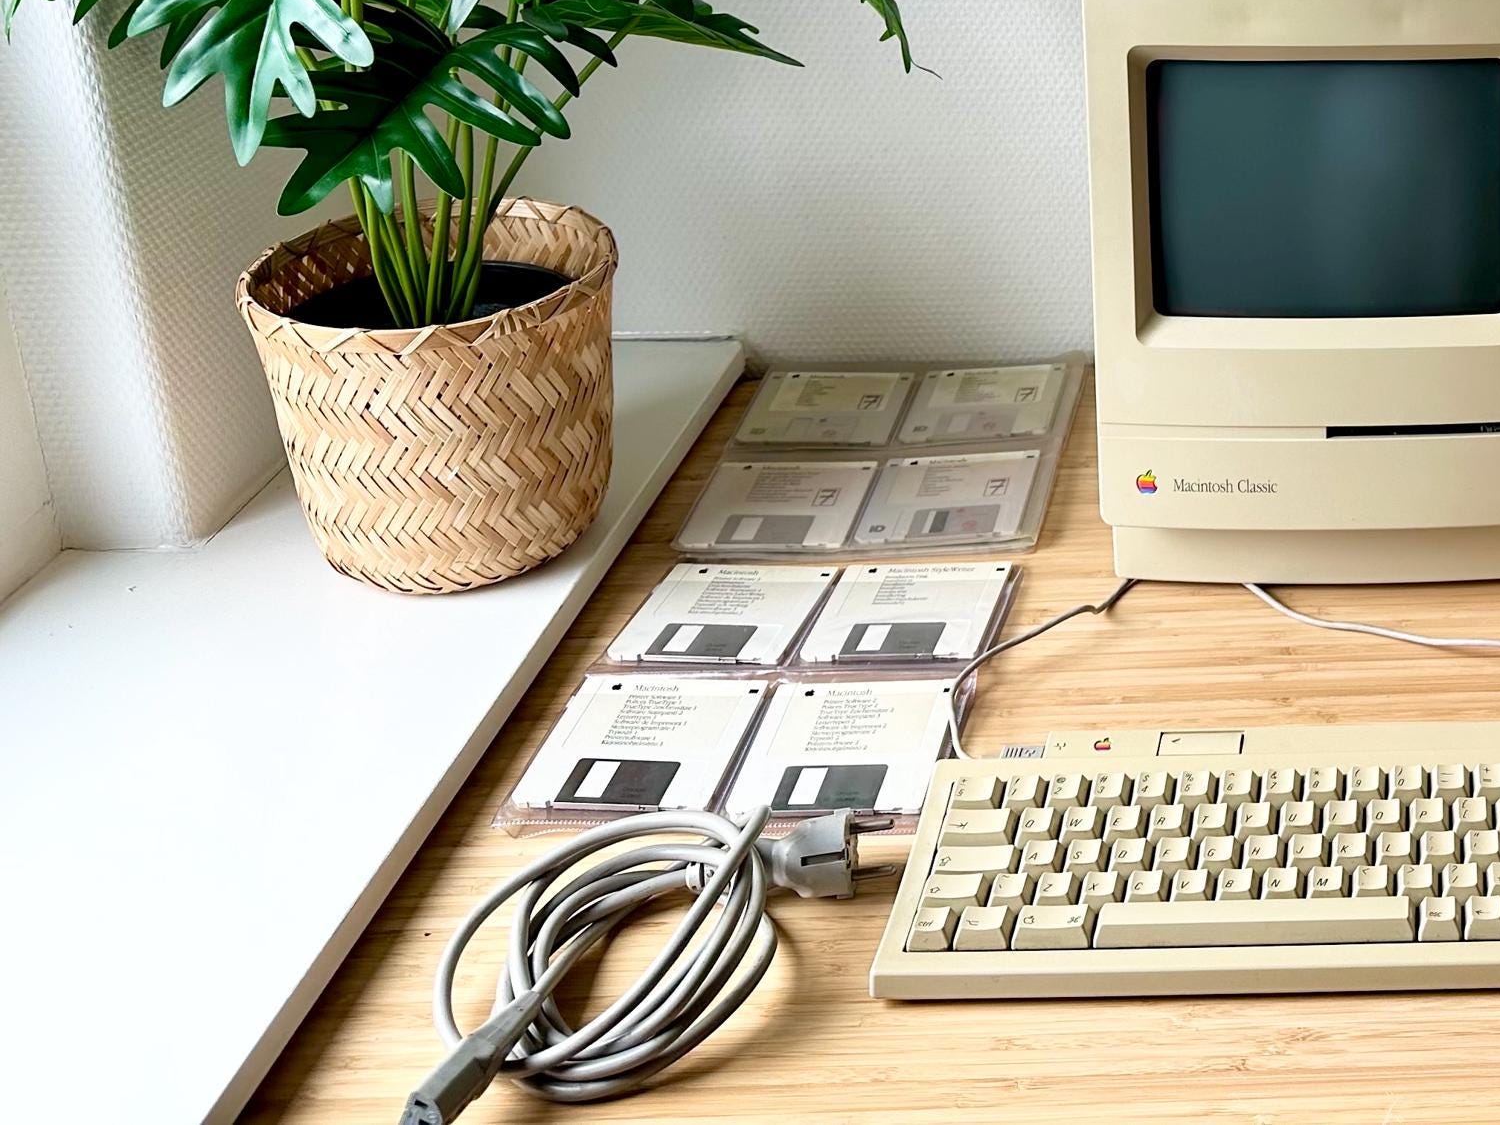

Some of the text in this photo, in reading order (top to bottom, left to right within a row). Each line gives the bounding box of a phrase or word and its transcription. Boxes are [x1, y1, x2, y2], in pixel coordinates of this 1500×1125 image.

[1173, 478, 1278, 493] Macintosh Classic
[827, 689, 873, 697] Macintosh
[1245, 815, 1253, 823] Y
[1288, 813, 1298, 823] U
[1419, 810, 1428, 819] P
[1069, 818, 1083, 827] W
[1112, 817, 1120, 826] E
[1156, 816, 1166, 825] R
[1201, 815, 1209, 824] T
[1162, 849, 1170, 857] F
[1206, 848, 1216, 857] G
[1251, 847, 1261, 856] H
[1295, 845, 1305, 854] J
[1340, 844, 1349, 853] K
[1385, 844, 1391, 853] L
[1028, 852, 1038, 860] A
[1072, 850, 1083, 860] S
[1117, 850, 1128, 859] D
[1088, 883, 1098, 891] X
[1134, 882, 1144, 891] C
[1180, 881, 1190, 889] V
[1225, 879, 1234, 888] B
[1270, 879, 1281, 888] N
[1316, 878, 1329, 887] M
[1042, 883, 1053, 892] Z
